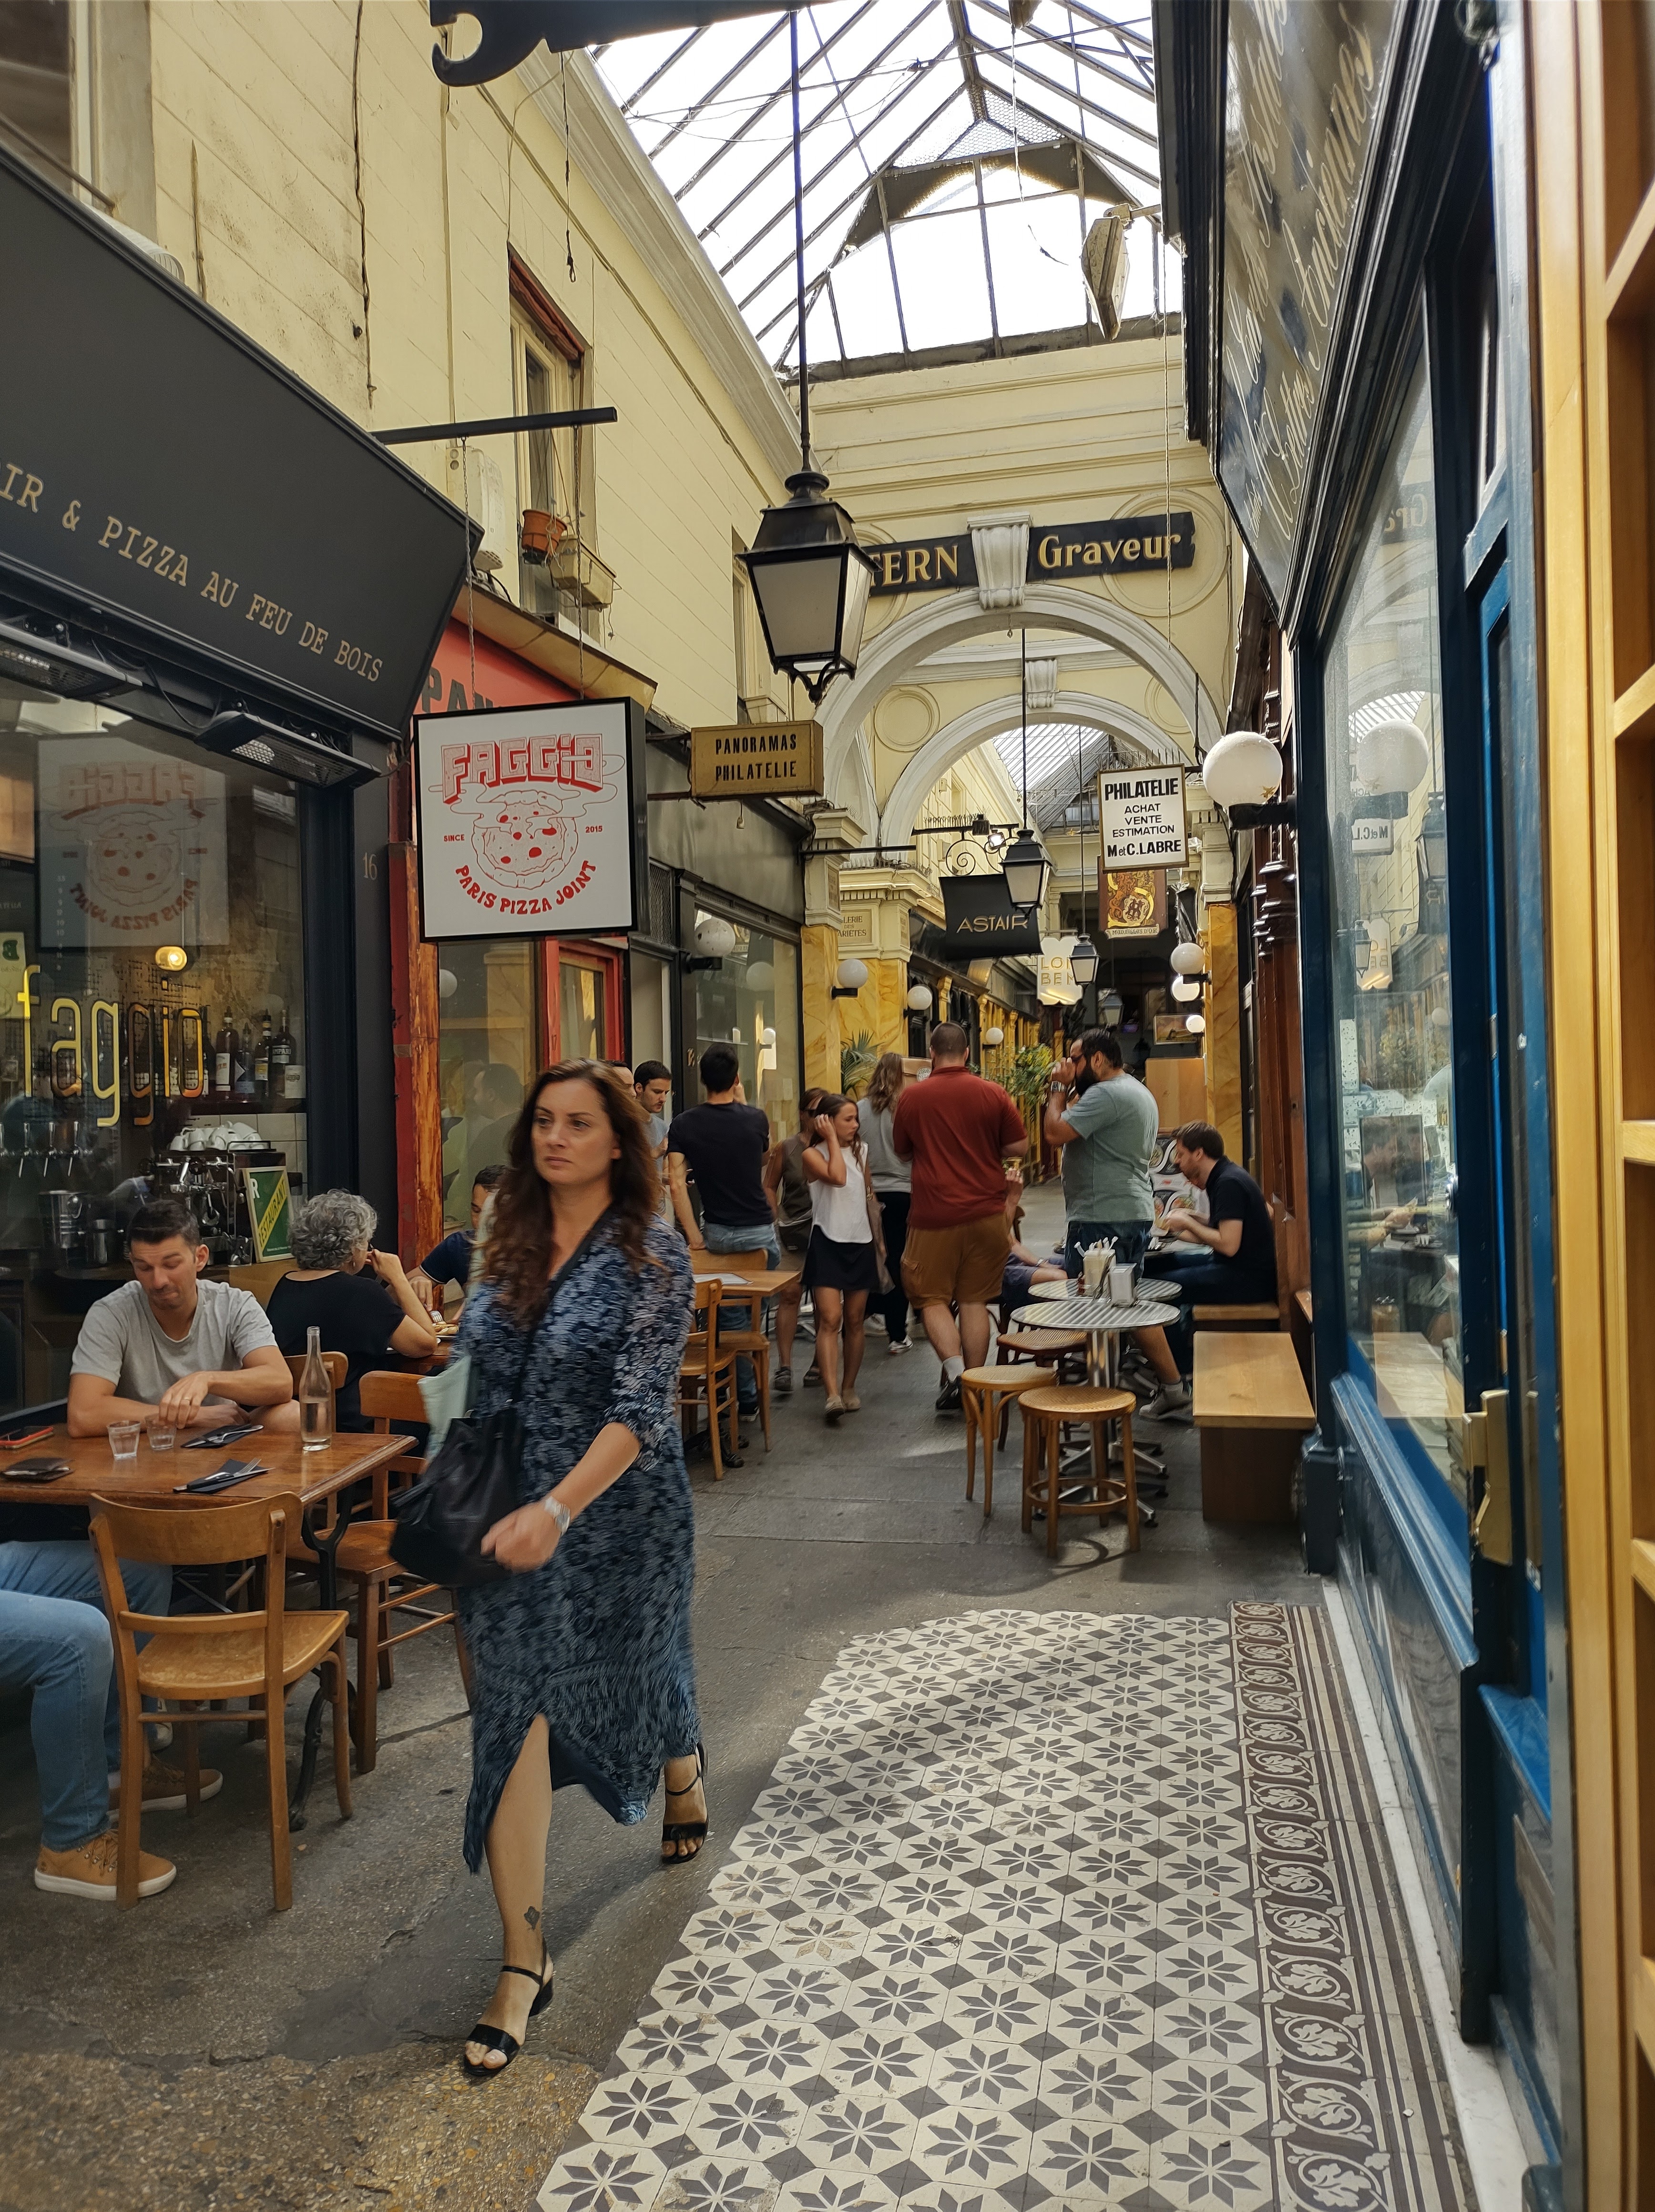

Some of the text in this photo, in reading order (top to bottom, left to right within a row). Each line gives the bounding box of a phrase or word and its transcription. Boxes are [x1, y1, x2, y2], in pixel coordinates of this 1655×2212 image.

[1038, 532, 1181, 570] Graveur
[0, 459, 383, 682] IR & PIZZA AU FEU DE BOIS
[715, 734, 797, 755] PANORAMAS
[715, 761, 797, 782] PHILATELIE
[1124, 803, 1161, 814] ACHAT
[1124, 815, 1162, 826] VENTE
[443, 825, 603, 842] SINCE 2015
[1113, 825, 1175, 838] ESTIMATION
[362, 852, 378, 881] 16
[455, 860, 597, 915] PARIS PIZZA JOINT
[956, 913, 1028, 934] ASTAIR
[17, 964, 204, 1127] faggio
[250, 1178, 260, 1199] R
